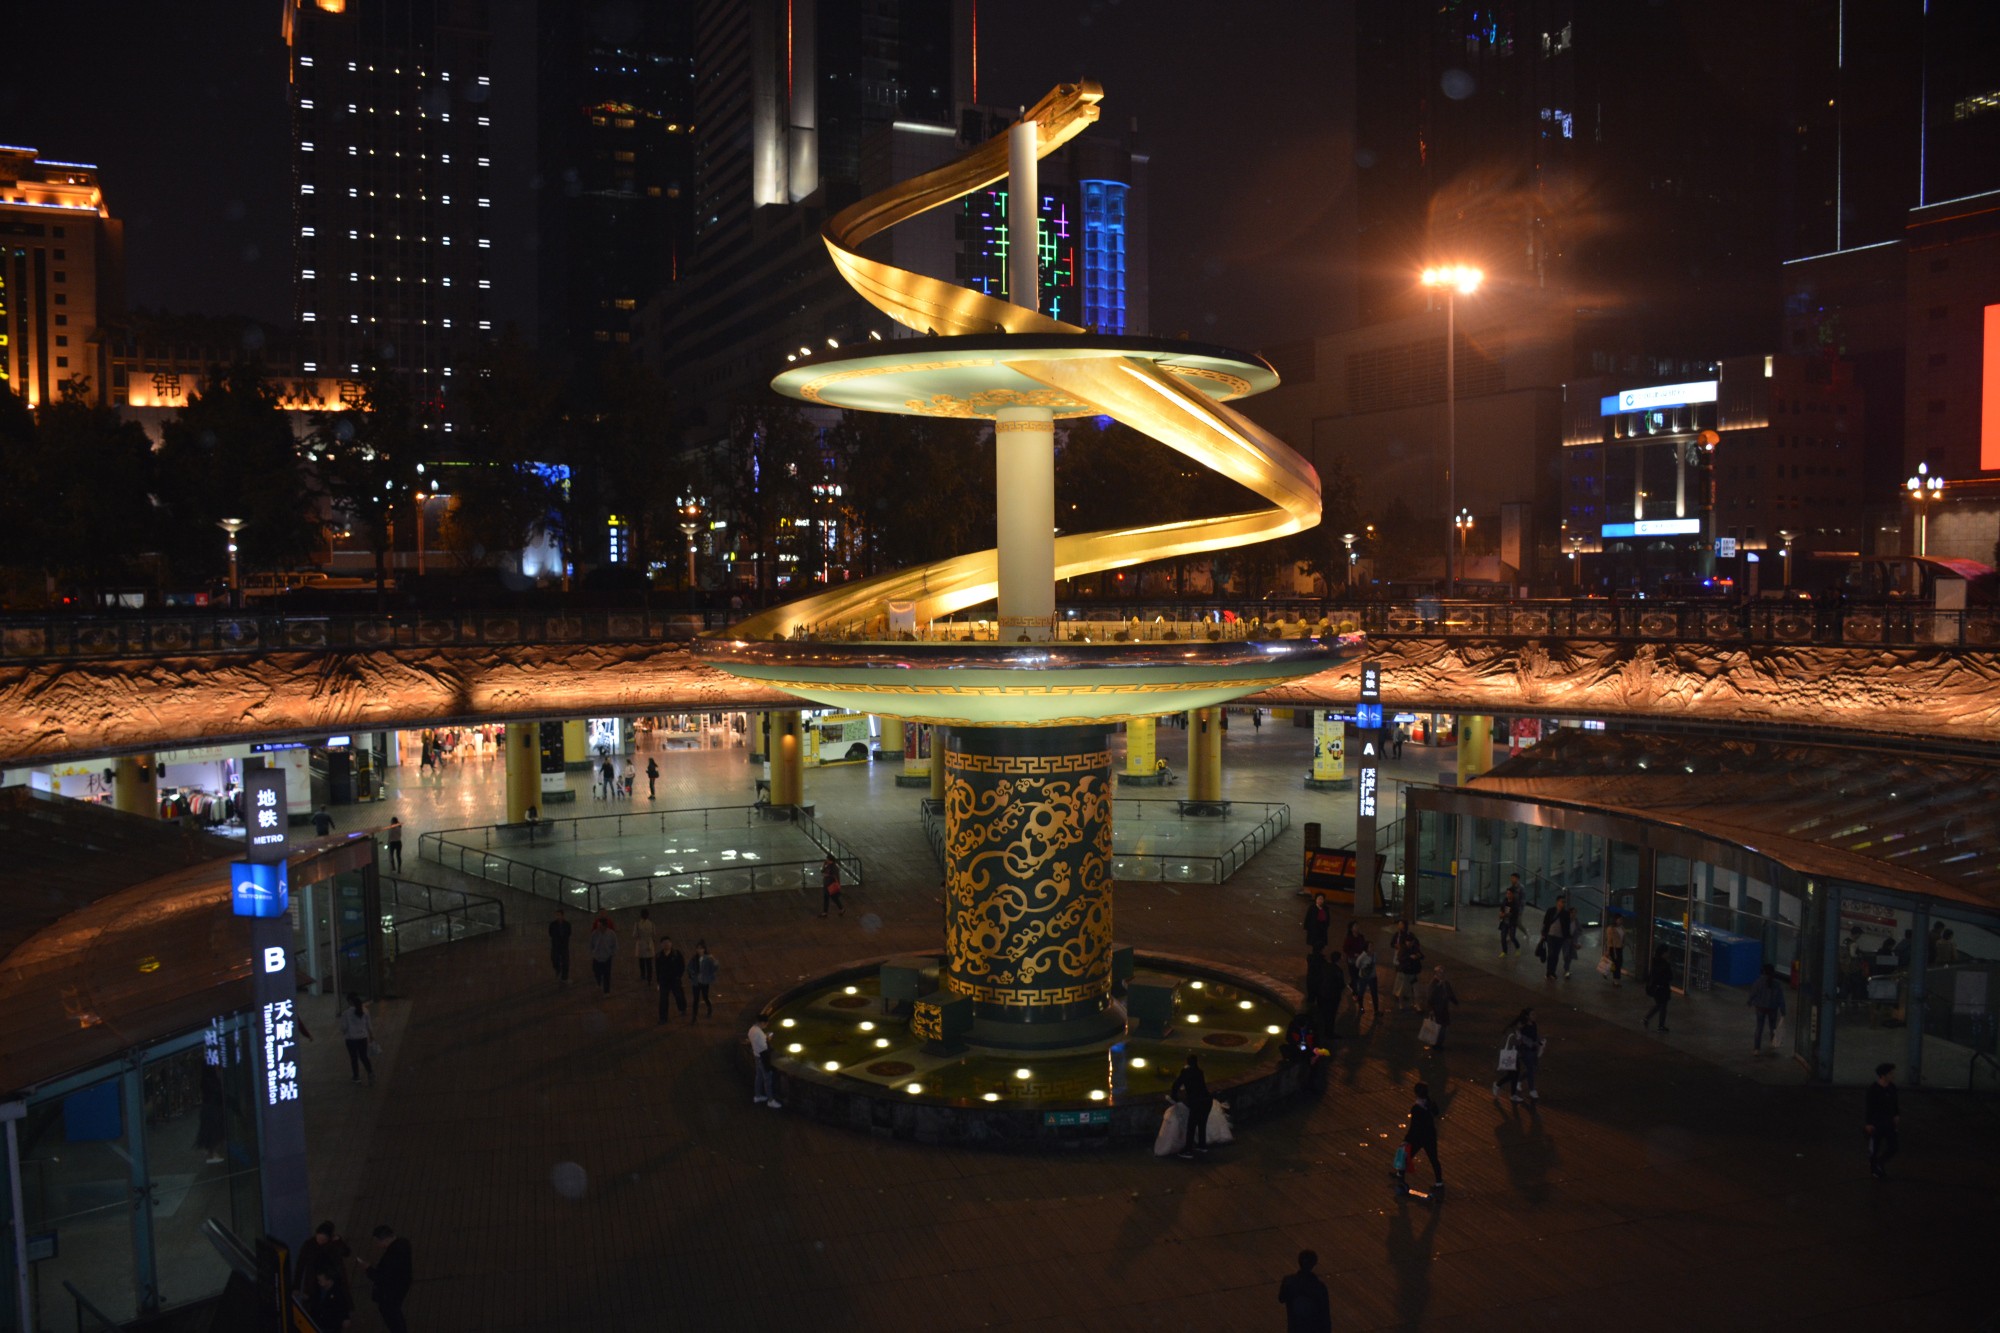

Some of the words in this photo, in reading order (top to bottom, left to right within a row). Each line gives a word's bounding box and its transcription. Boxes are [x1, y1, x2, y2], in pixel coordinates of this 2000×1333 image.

[1366, 670, 1375, 688] 地铁
[1363, 742, 1375, 756] A
[257, 789, 278, 828] 地铁
[254, 834, 284, 845] METRO
[264, 947, 286, 973] B
[264, 1003, 274, 1034] Tianfu
[265, 1035, 275, 1069] Square
[275, 999, 298, 1101] 天府广场站
[268, 1070, 278, 1105] Station
